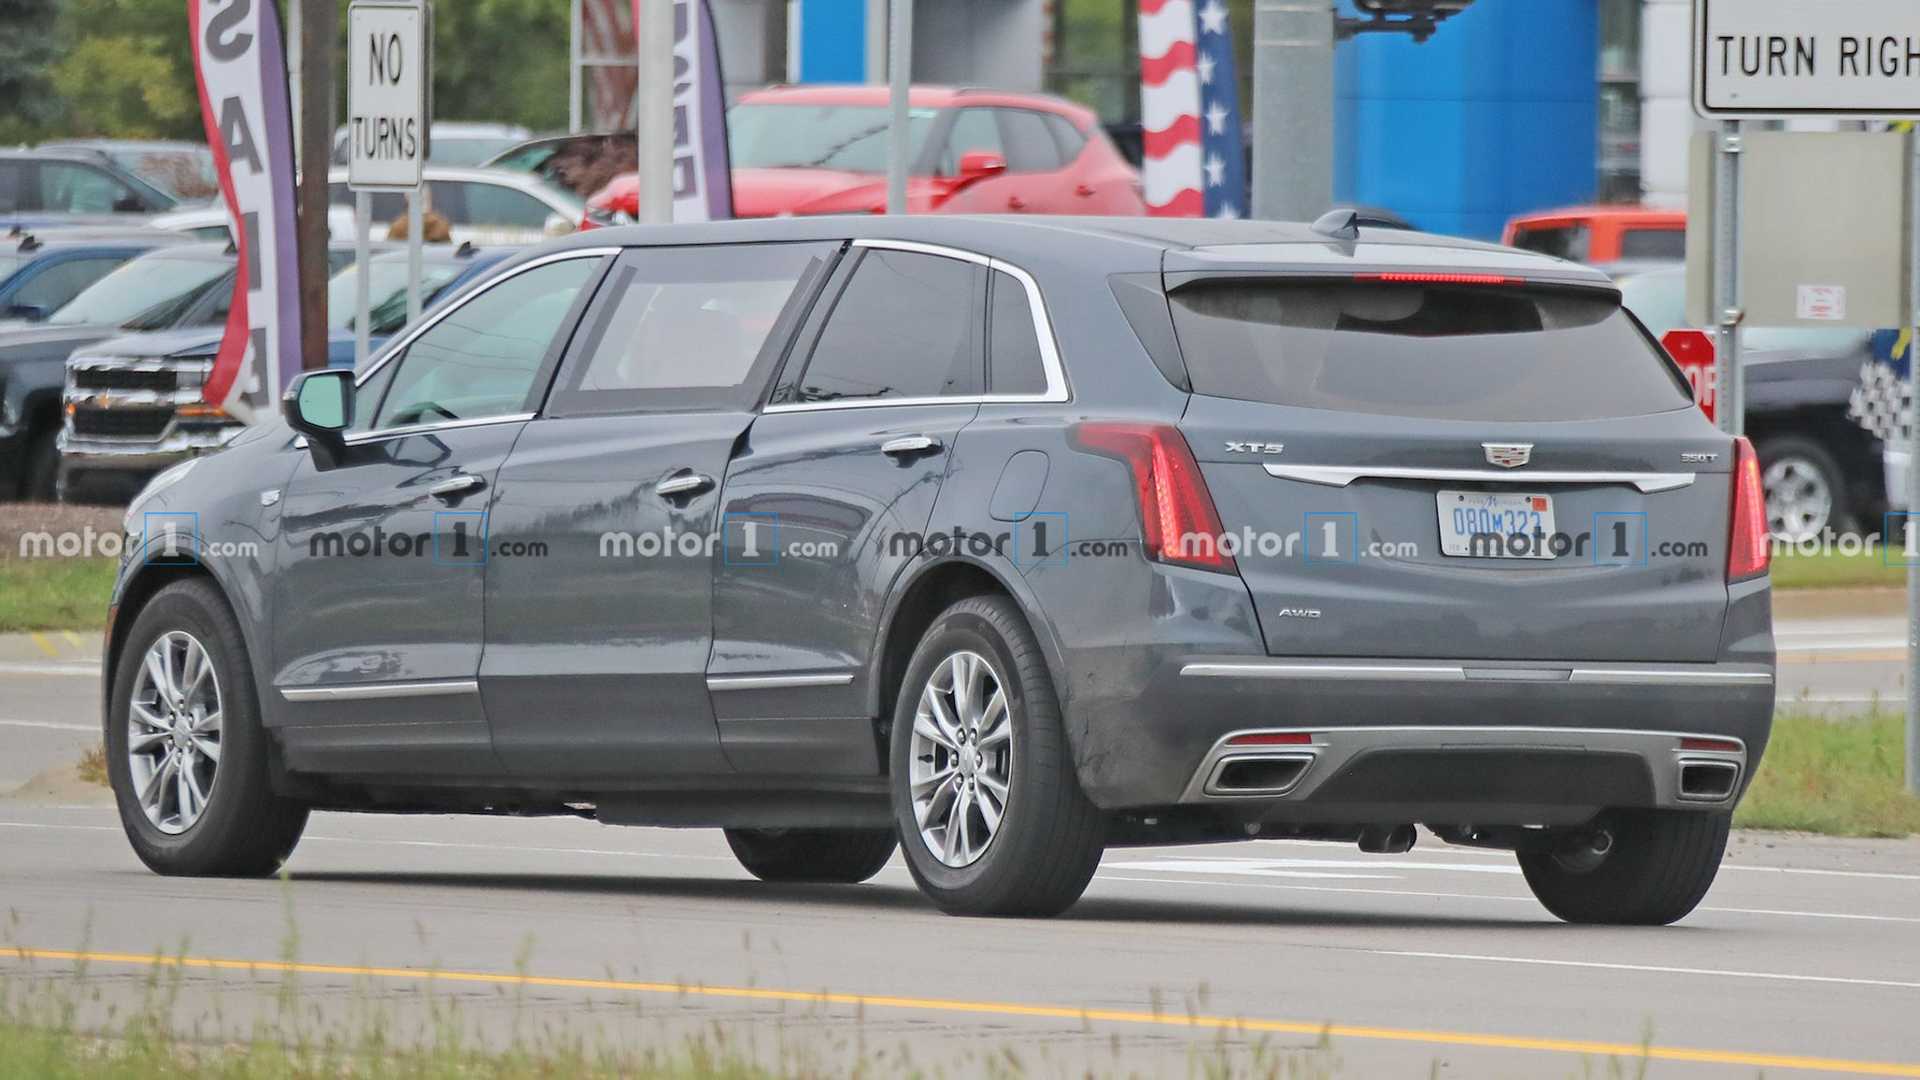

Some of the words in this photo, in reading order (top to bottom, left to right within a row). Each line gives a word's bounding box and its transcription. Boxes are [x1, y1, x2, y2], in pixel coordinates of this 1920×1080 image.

[368, 32, 402, 86] NO
[1718, 36, 1815, 77] TURN
[1839, 36, 1920, 77] RIGH
[351, 117, 416, 160] TURNS
[1279, 608, 1321, 618] AWD
